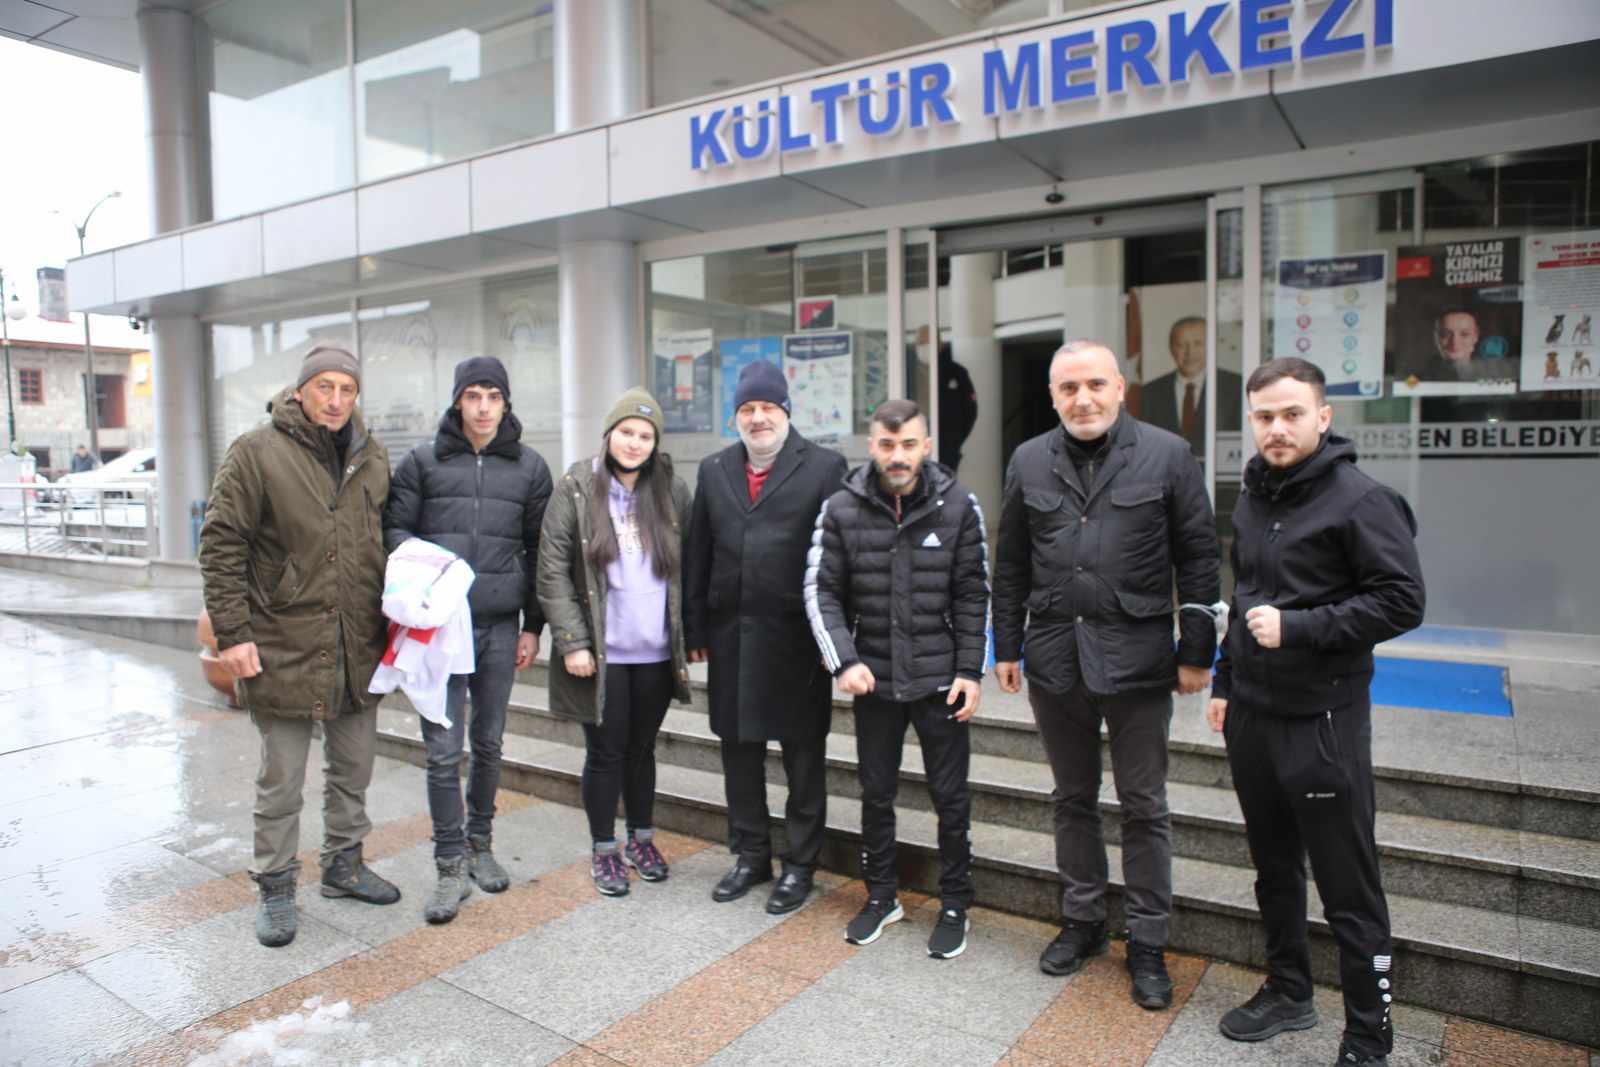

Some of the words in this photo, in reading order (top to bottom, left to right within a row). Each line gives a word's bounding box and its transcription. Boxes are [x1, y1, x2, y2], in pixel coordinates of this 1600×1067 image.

[689, 62, 957, 171] KÜLTÜR
[1446, 241, 1504, 257] YAYALAR
[1445, 254, 1503, 271] KIRMIZI
